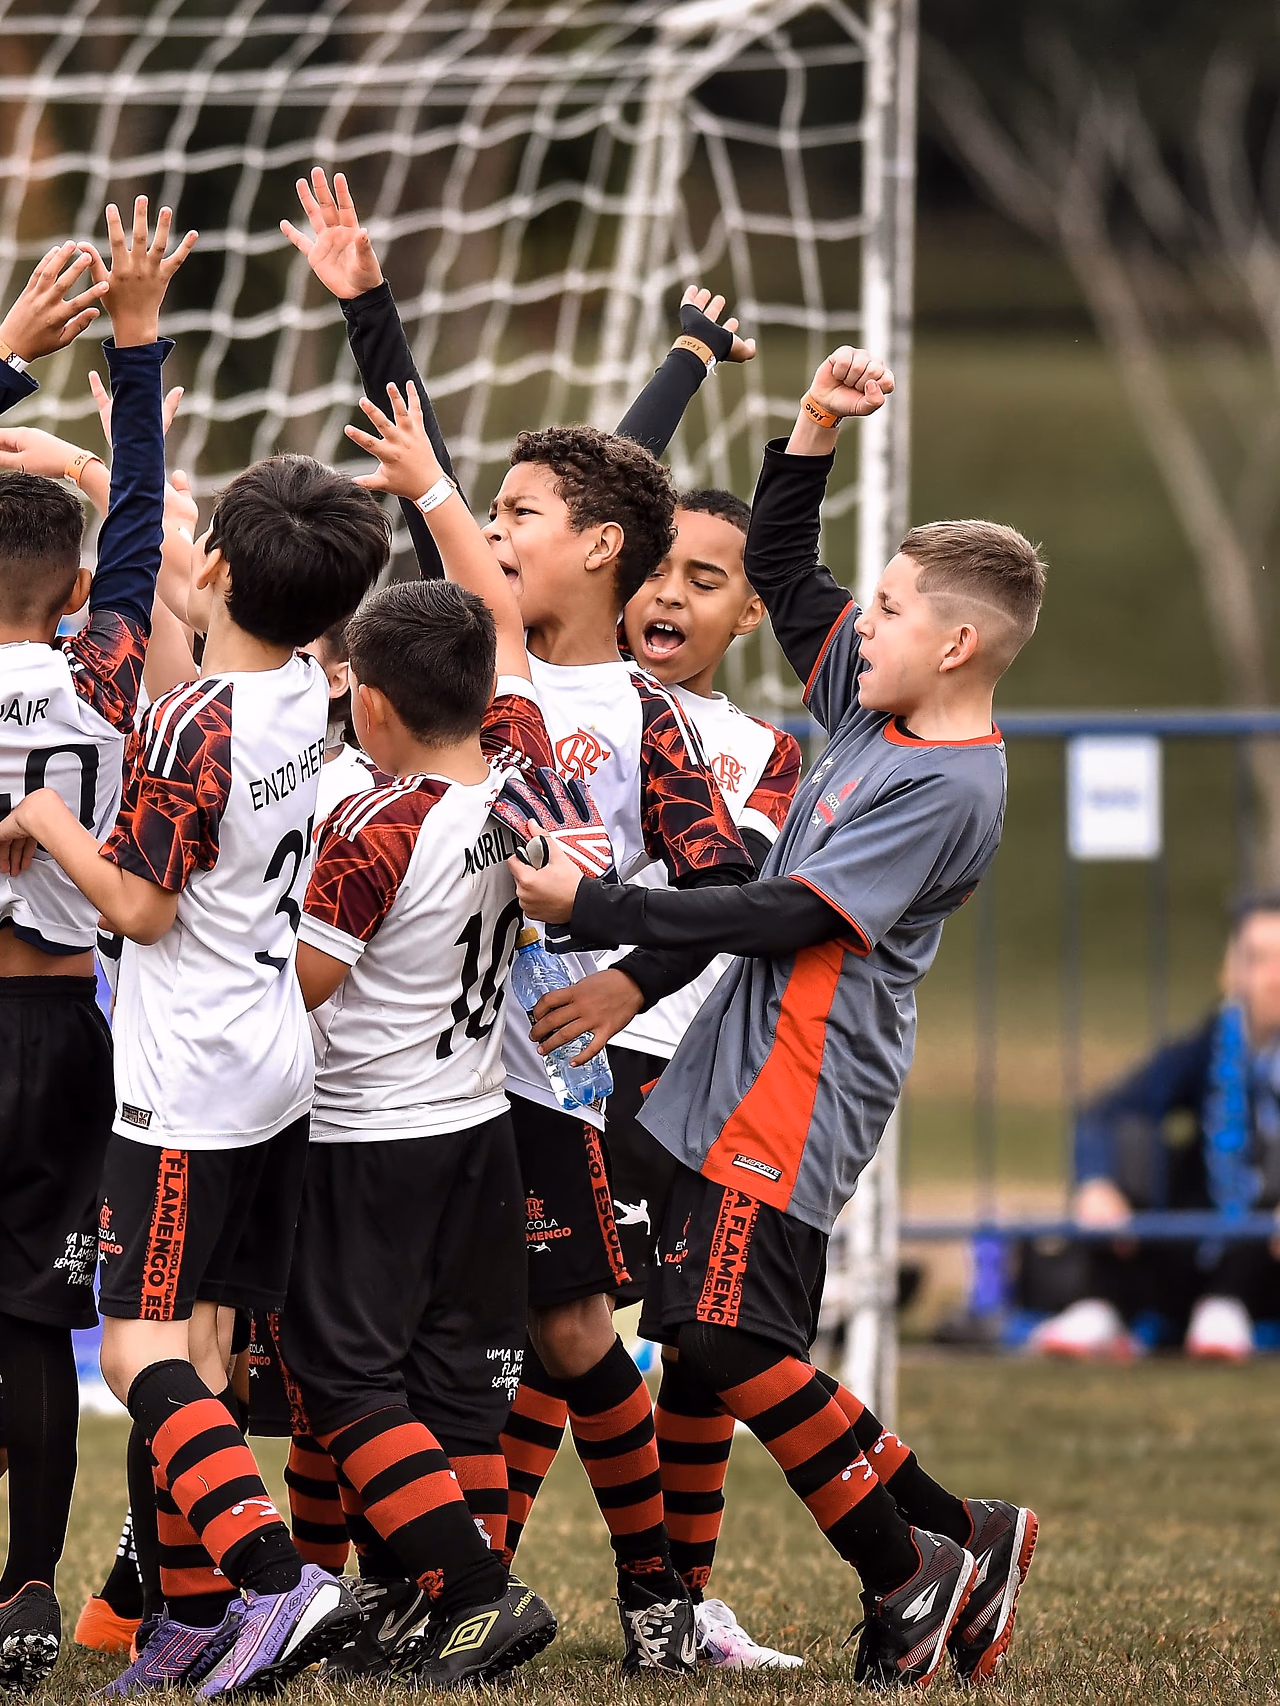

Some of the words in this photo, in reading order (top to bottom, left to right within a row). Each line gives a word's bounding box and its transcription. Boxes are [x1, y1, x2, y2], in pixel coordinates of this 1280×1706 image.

[249, 761, 297, 811] ENZO
[436, 898, 524, 1060] 10
[147, 1157, 182, 1288] FLAMENGO
[525, 1218, 559, 1231] COLA
[711, 1200, 732, 1258] FLAMENGO
[169, 1240, 181, 1279] ESCOLA
[699, 1266, 716, 1306] ESCOLA
[729, 1272, 745, 1310] ESCOLA
[486, 1349, 511, 1361] UMA
[512, 1590, 536, 1617] umbro
